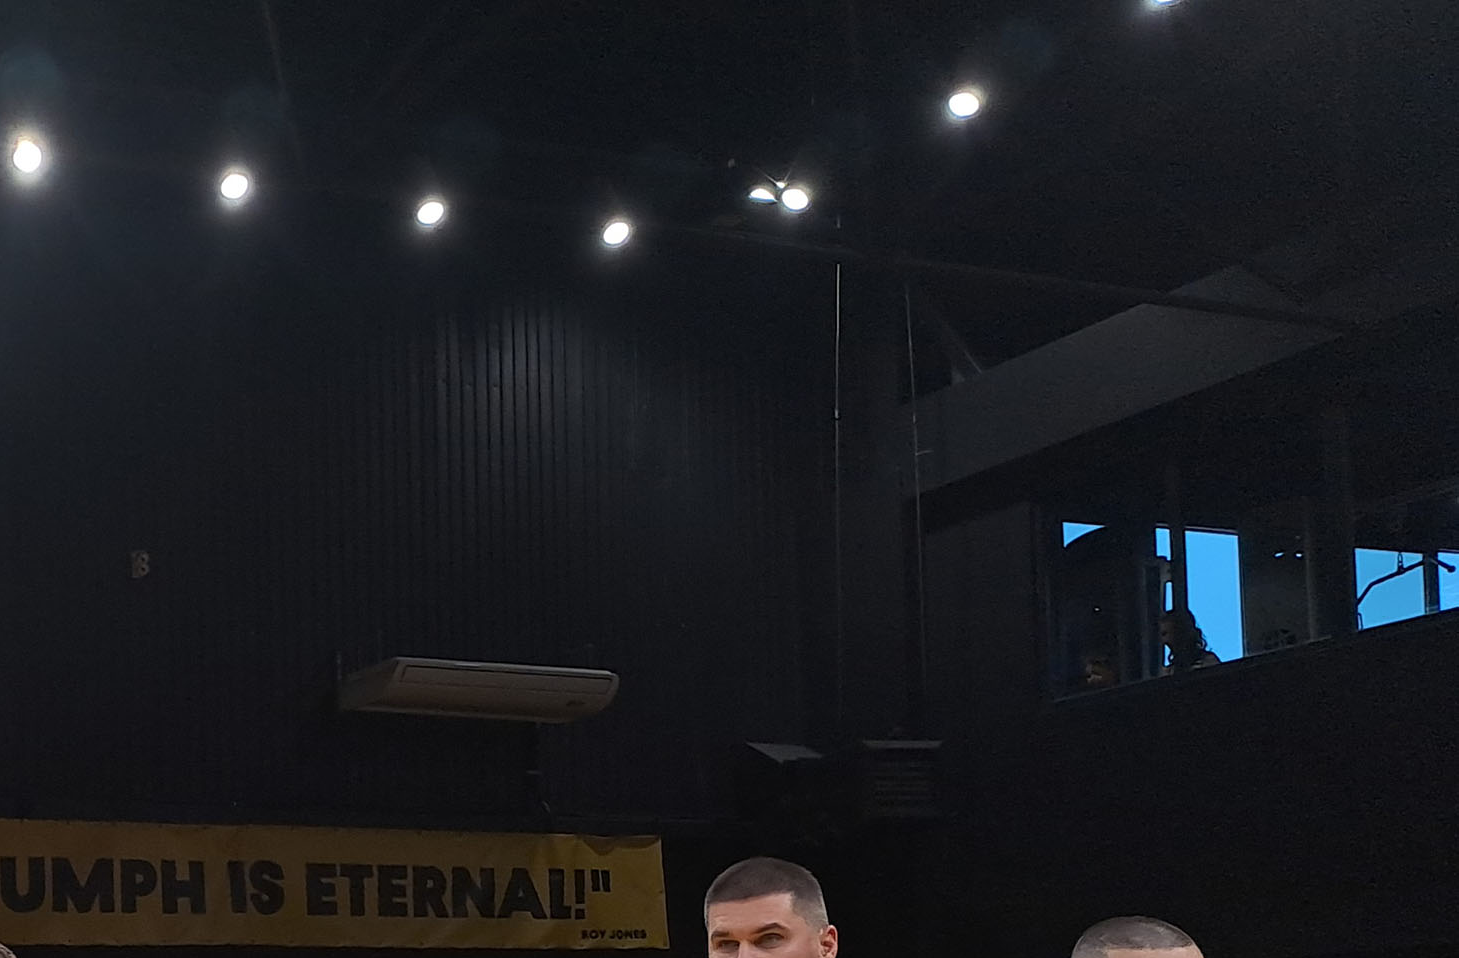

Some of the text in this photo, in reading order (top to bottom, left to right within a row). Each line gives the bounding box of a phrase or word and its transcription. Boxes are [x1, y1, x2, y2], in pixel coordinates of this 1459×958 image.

[228, 860, 286, 916] IS
[304, 862, 611, 921] ETERNAL!"
[581, 929, 647, 940] ROY JONES
